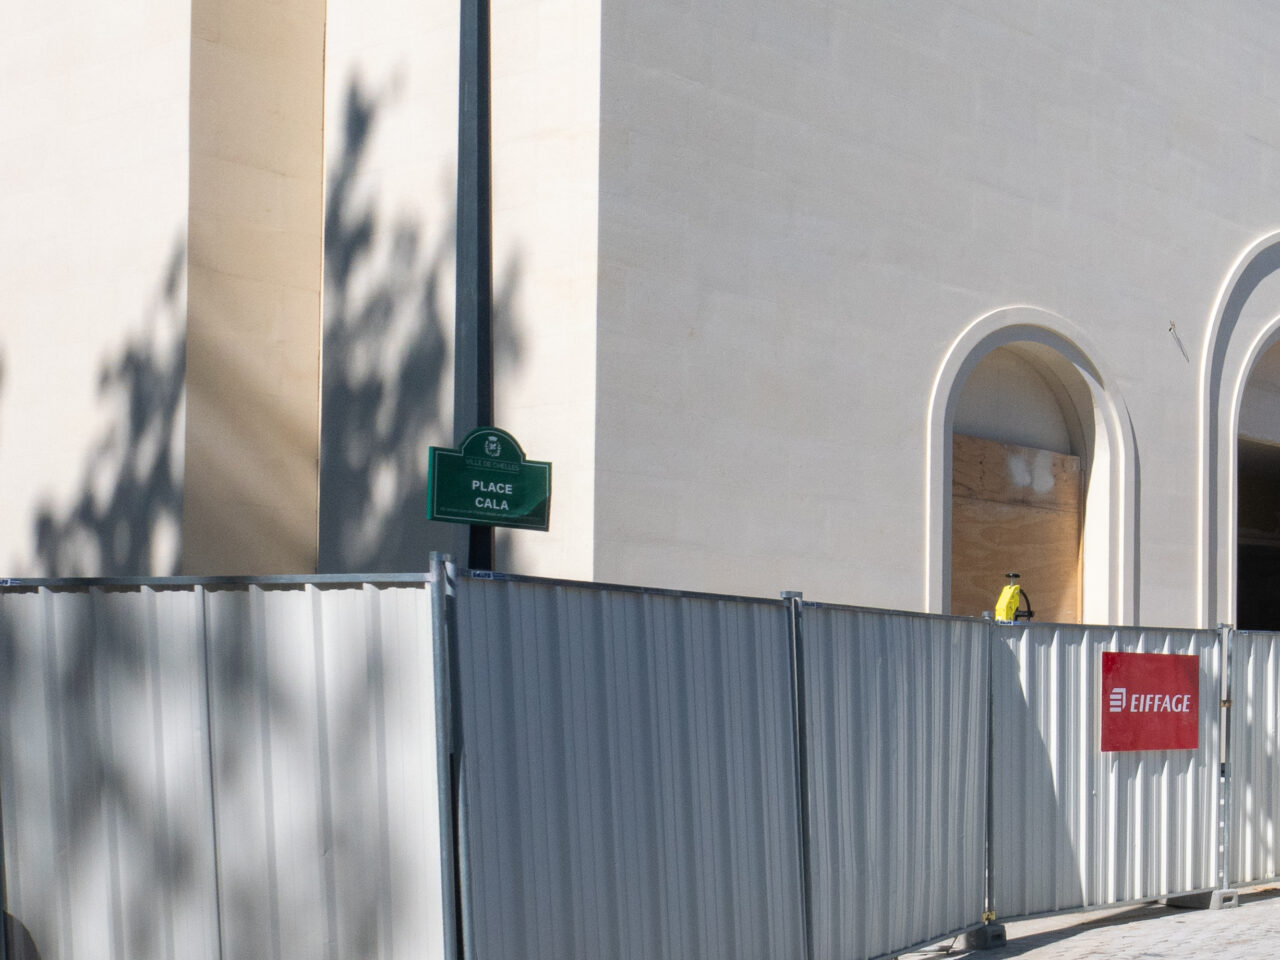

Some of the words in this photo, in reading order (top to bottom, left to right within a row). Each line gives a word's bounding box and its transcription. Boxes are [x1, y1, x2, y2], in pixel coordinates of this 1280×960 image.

[465, 458, 481, 466] VILLE
[472, 480, 513, 495] PLACE
[475, 497, 509, 510] CALA
[1130, 694, 1191, 713] EIFFAGE
